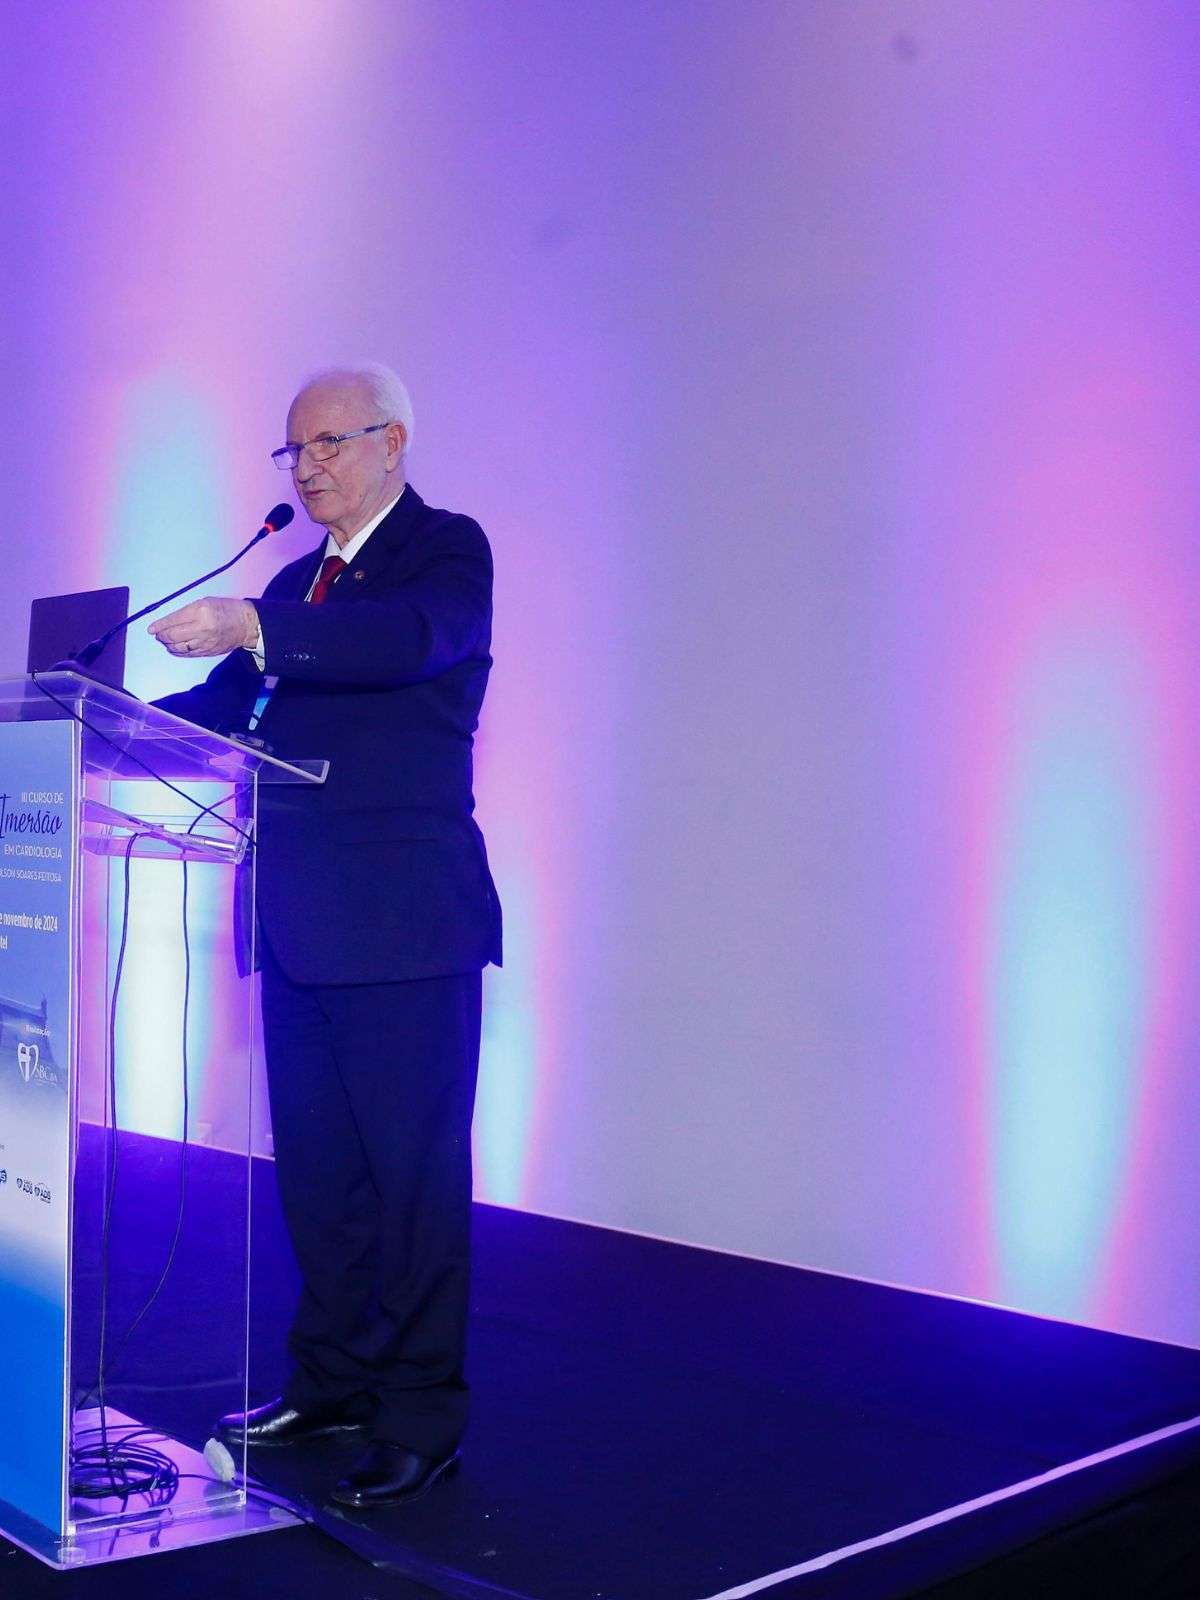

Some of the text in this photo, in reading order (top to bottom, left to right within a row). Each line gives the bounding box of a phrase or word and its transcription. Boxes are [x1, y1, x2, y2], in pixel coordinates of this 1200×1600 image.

[28, 791, 54, 804] CURSO
[54, 792, 64, 804] DE
[4, 844, 63, 859] EM CARDIOLOGIA
[3, 912, 34, 929] novembro
[34, 914, 42, 930] de
[42, 915, 58, 932] 2024
